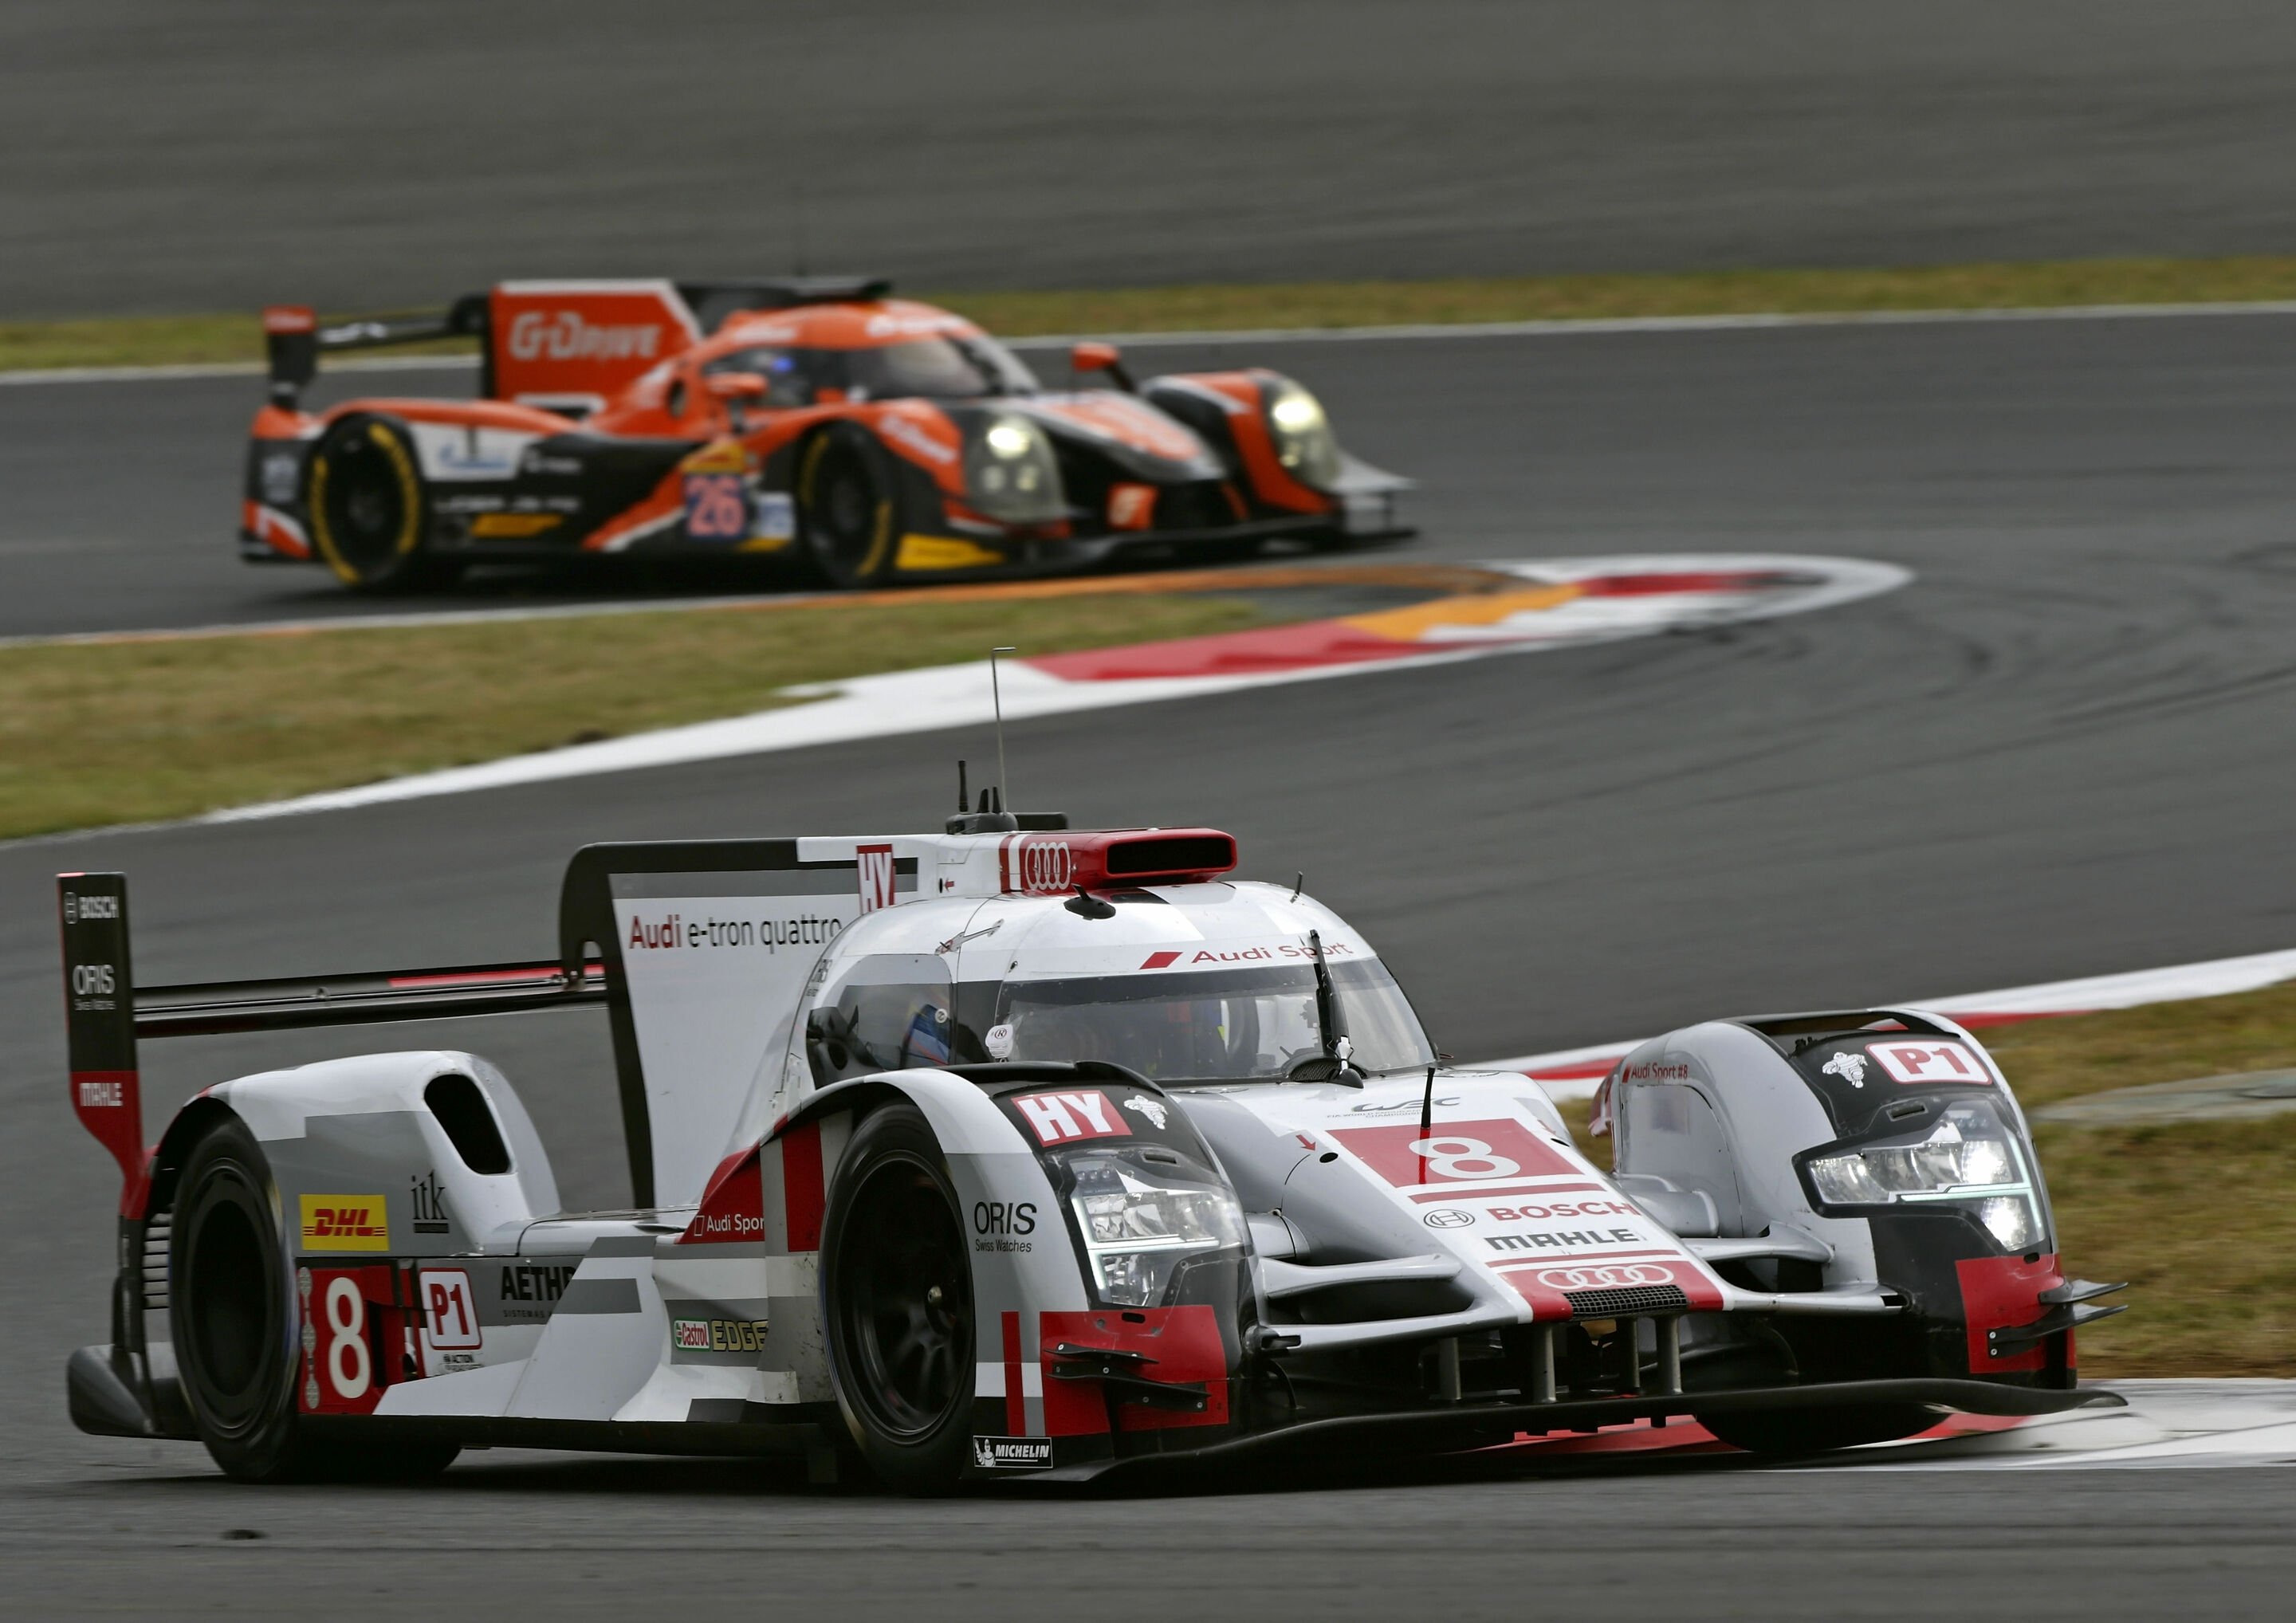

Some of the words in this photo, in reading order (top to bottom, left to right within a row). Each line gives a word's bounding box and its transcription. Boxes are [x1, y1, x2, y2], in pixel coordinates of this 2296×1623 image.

[686, 474, 745, 536] 26
[858, 853, 893, 914] HY
[79, 896, 119, 918] BOSCH
[629, 914, 682, 949] Audi
[687, 918, 754, 947] e-tron
[760, 914, 842, 954] quattro
[1191, 947, 1272, 963] Audi
[1278, 942, 1354, 959] Sport
[73, 965, 116, 995] ORIS
[1631, 1063, 1650, 1079] Audi
[1653, 1062, 1676, 1080] Sport
[1678, 1064, 1689, 1079] #8
[1889, 1047, 1970, 1075] P1
[80, 1083, 123, 1106] MAHLE
[1017, 1093, 1113, 1142] HY
[1408, 1136, 1520, 1179] 8
[411, 1169, 448, 1220] itk
[314, 1208, 375, 1236] DHL
[706, 1214, 731, 1232] Audi
[734, 1213, 765, 1235] Spor
[974, 1201, 1037, 1235] ORIS
[1485, 1201, 1641, 1221] BOSCH
[975, 1238, 994, 1252] Swiss
[996, 1239, 1032, 1252] Watches
[1484, 1228, 1640, 1251] MAHLE
[429, 1283, 470, 1335] P1
[326, 1277, 371, 1398] 8
[682, 1322, 709, 1346] Castrol
[711, 1319, 769, 1352] EDGE
[995, 1444, 1050, 1458] MICHELIN
